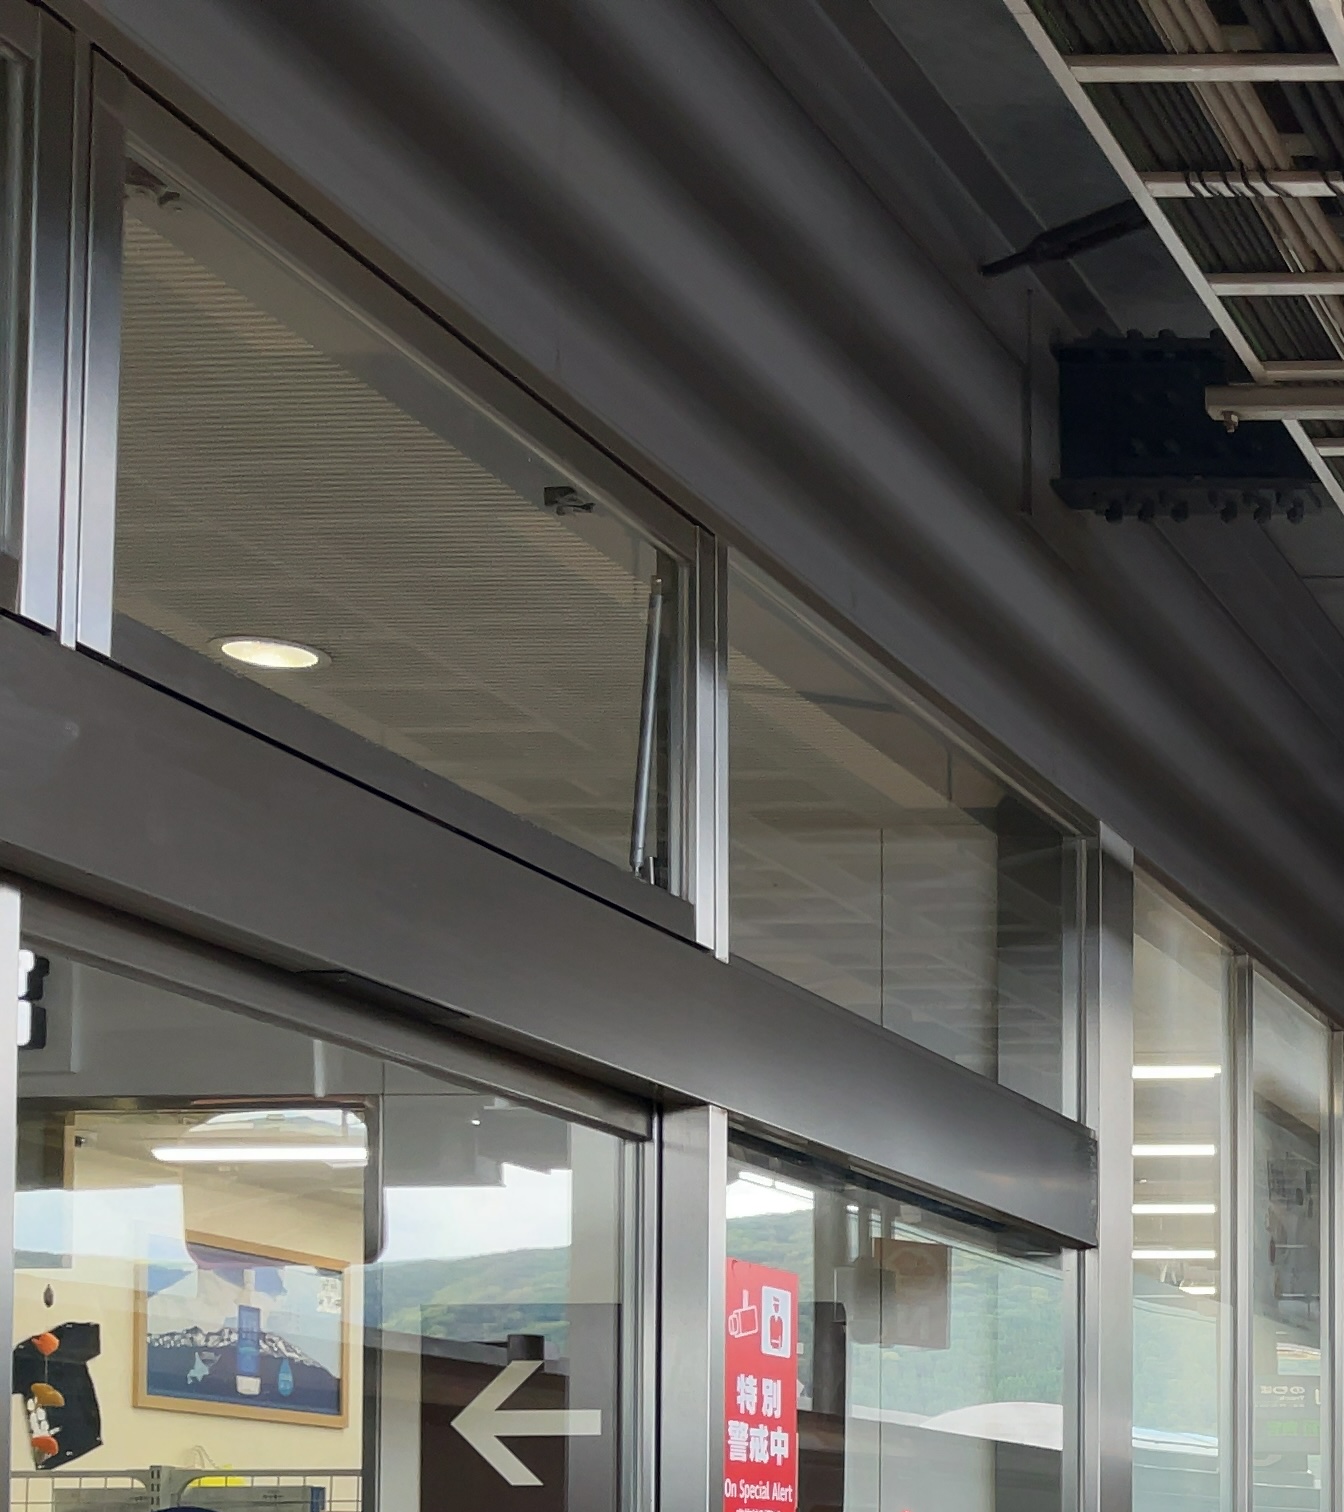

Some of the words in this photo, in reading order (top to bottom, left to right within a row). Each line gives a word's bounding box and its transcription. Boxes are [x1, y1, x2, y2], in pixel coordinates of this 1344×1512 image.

[735, 1373, 782, 1419] 特別
[727, 1419, 789, 1466] 警戒中
[724, 1479, 737, 1498] On
[739, 1479, 770, 1504] Special
[772, 1481, 793, 1502] Alert
